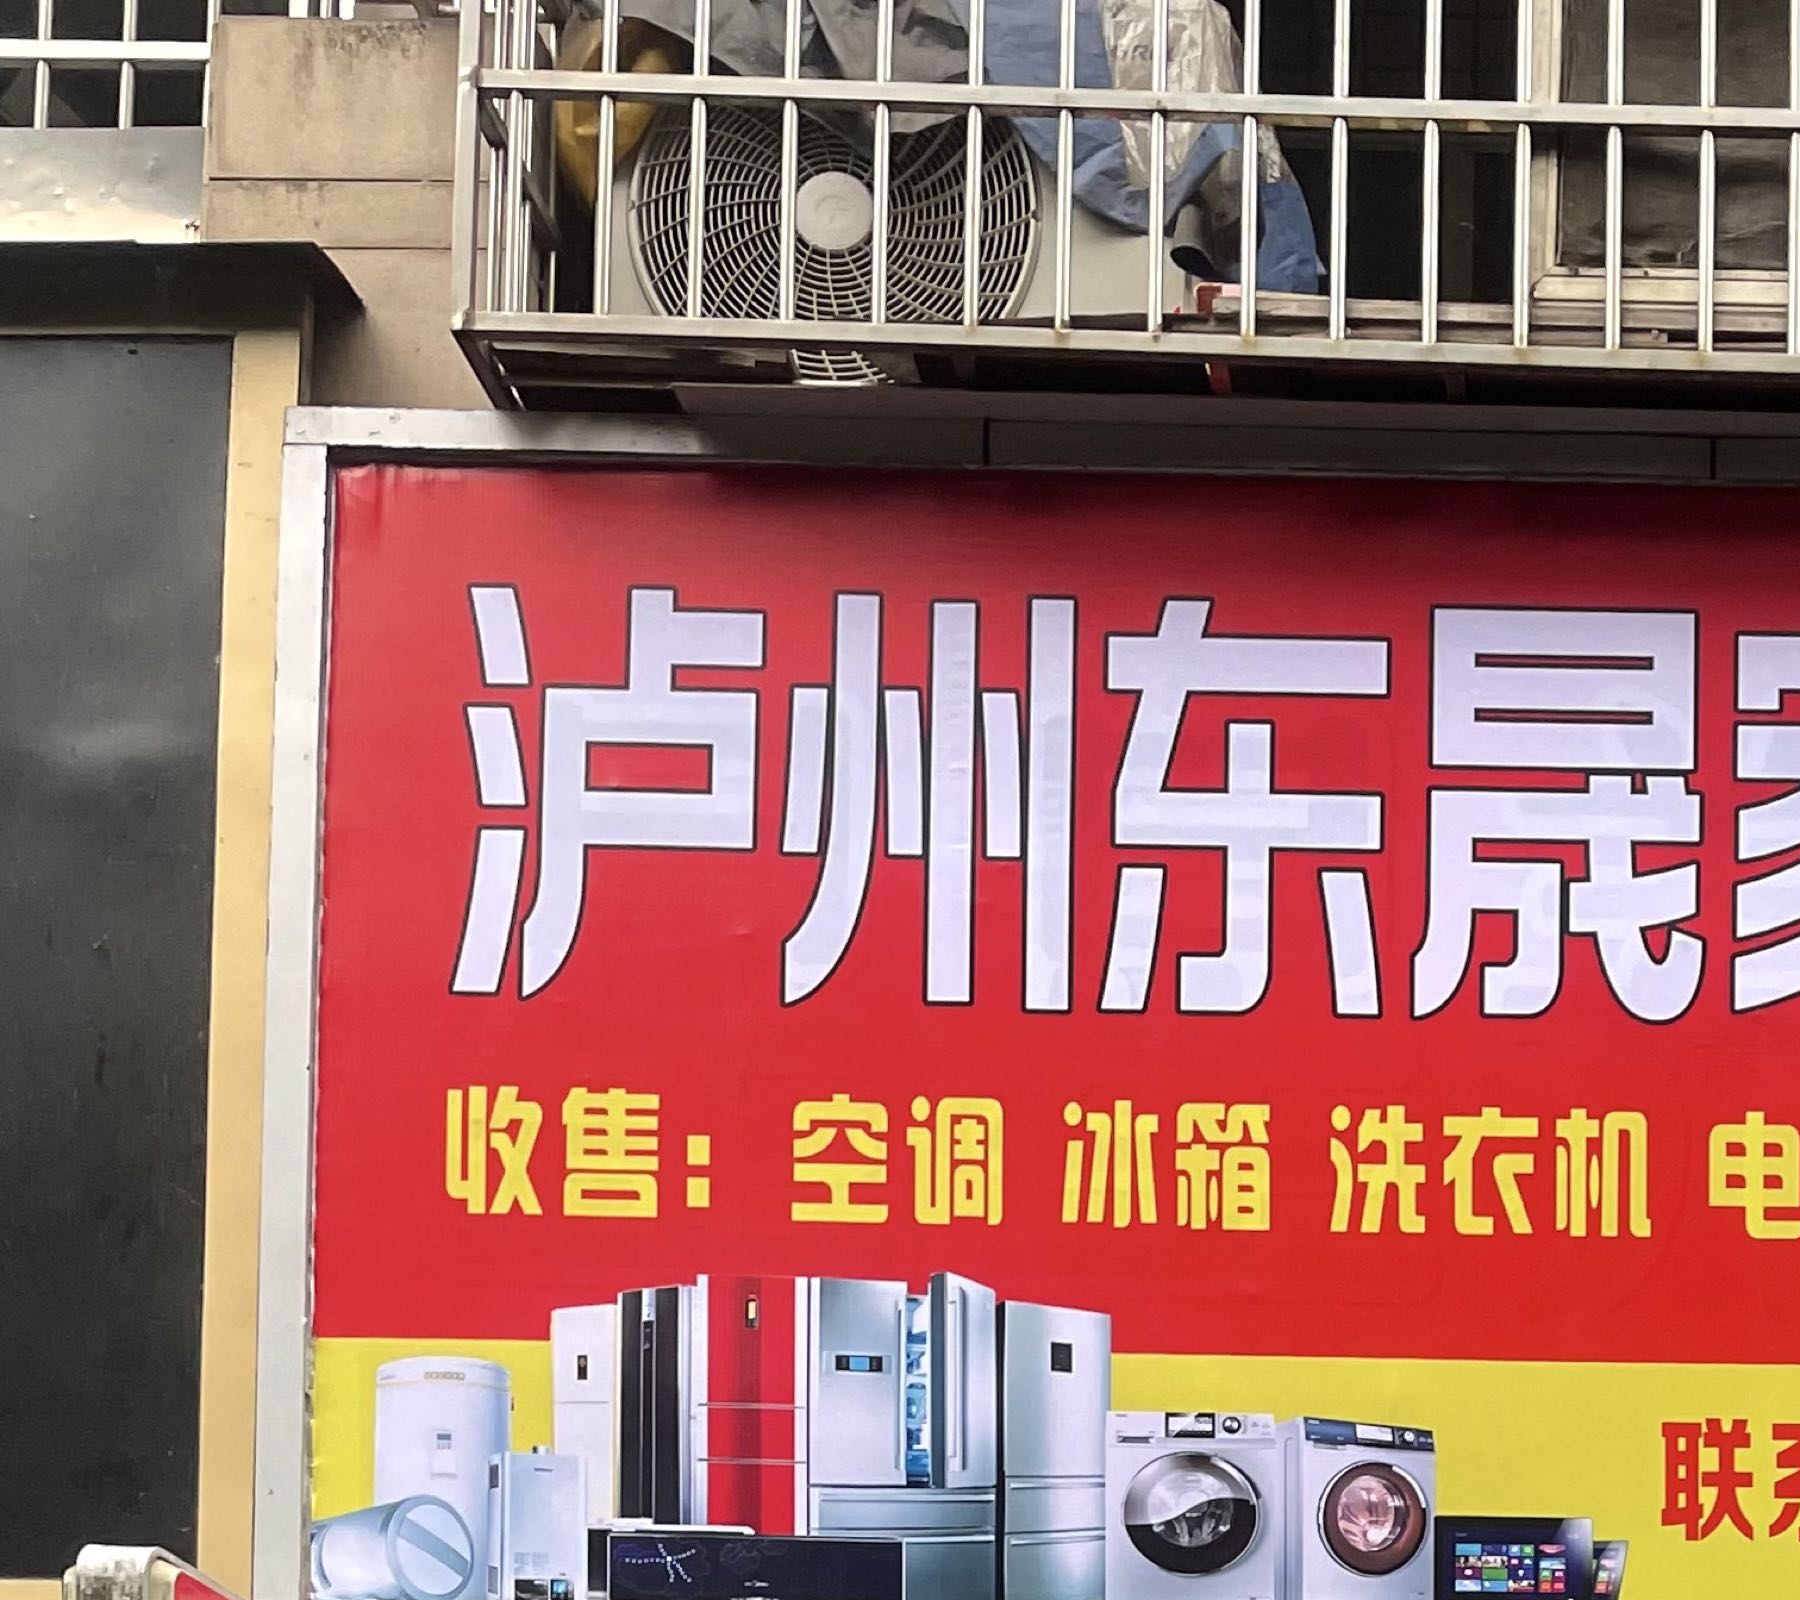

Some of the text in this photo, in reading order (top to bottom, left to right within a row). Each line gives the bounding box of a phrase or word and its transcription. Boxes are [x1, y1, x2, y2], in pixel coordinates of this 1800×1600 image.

[790, 1092, 1004, 1227] 空调
[1061, 1098, 1273, 1233] 冰箱
[1328, 1103, 1653, 1240] 洗衣机
